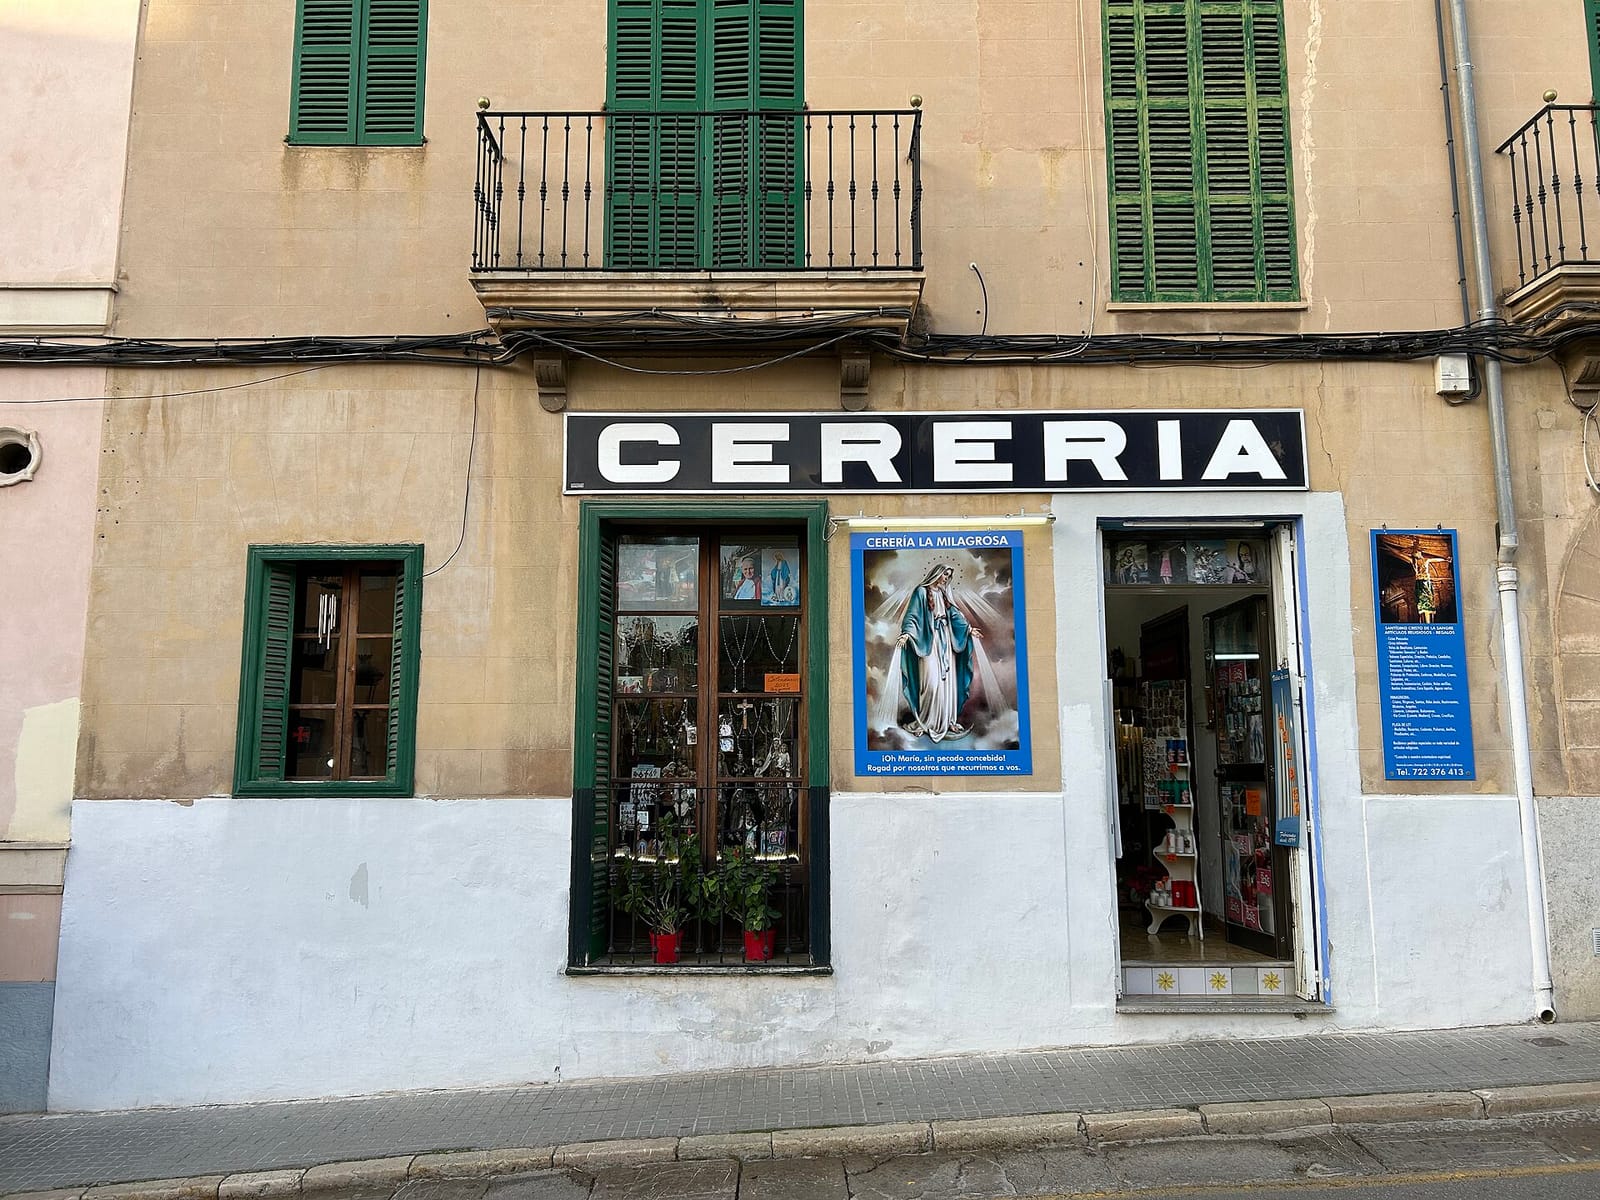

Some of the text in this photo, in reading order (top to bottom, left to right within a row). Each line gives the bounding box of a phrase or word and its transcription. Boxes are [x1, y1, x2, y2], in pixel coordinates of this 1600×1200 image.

[598, 419, 1288, 484] CERERIA
[866, 534, 1008, 548] CERERÍA LA MILAGROSA
[882, 755, 1006, 764] ¡Oh María, sin pecado concebido!
[867, 764, 890, 773] Rogad
[908, 764, 939, 772] nosotros
[957, 764, 997, 772] recurrimos
[1397, 768, 1464, 776] Tel. 722 376 413
